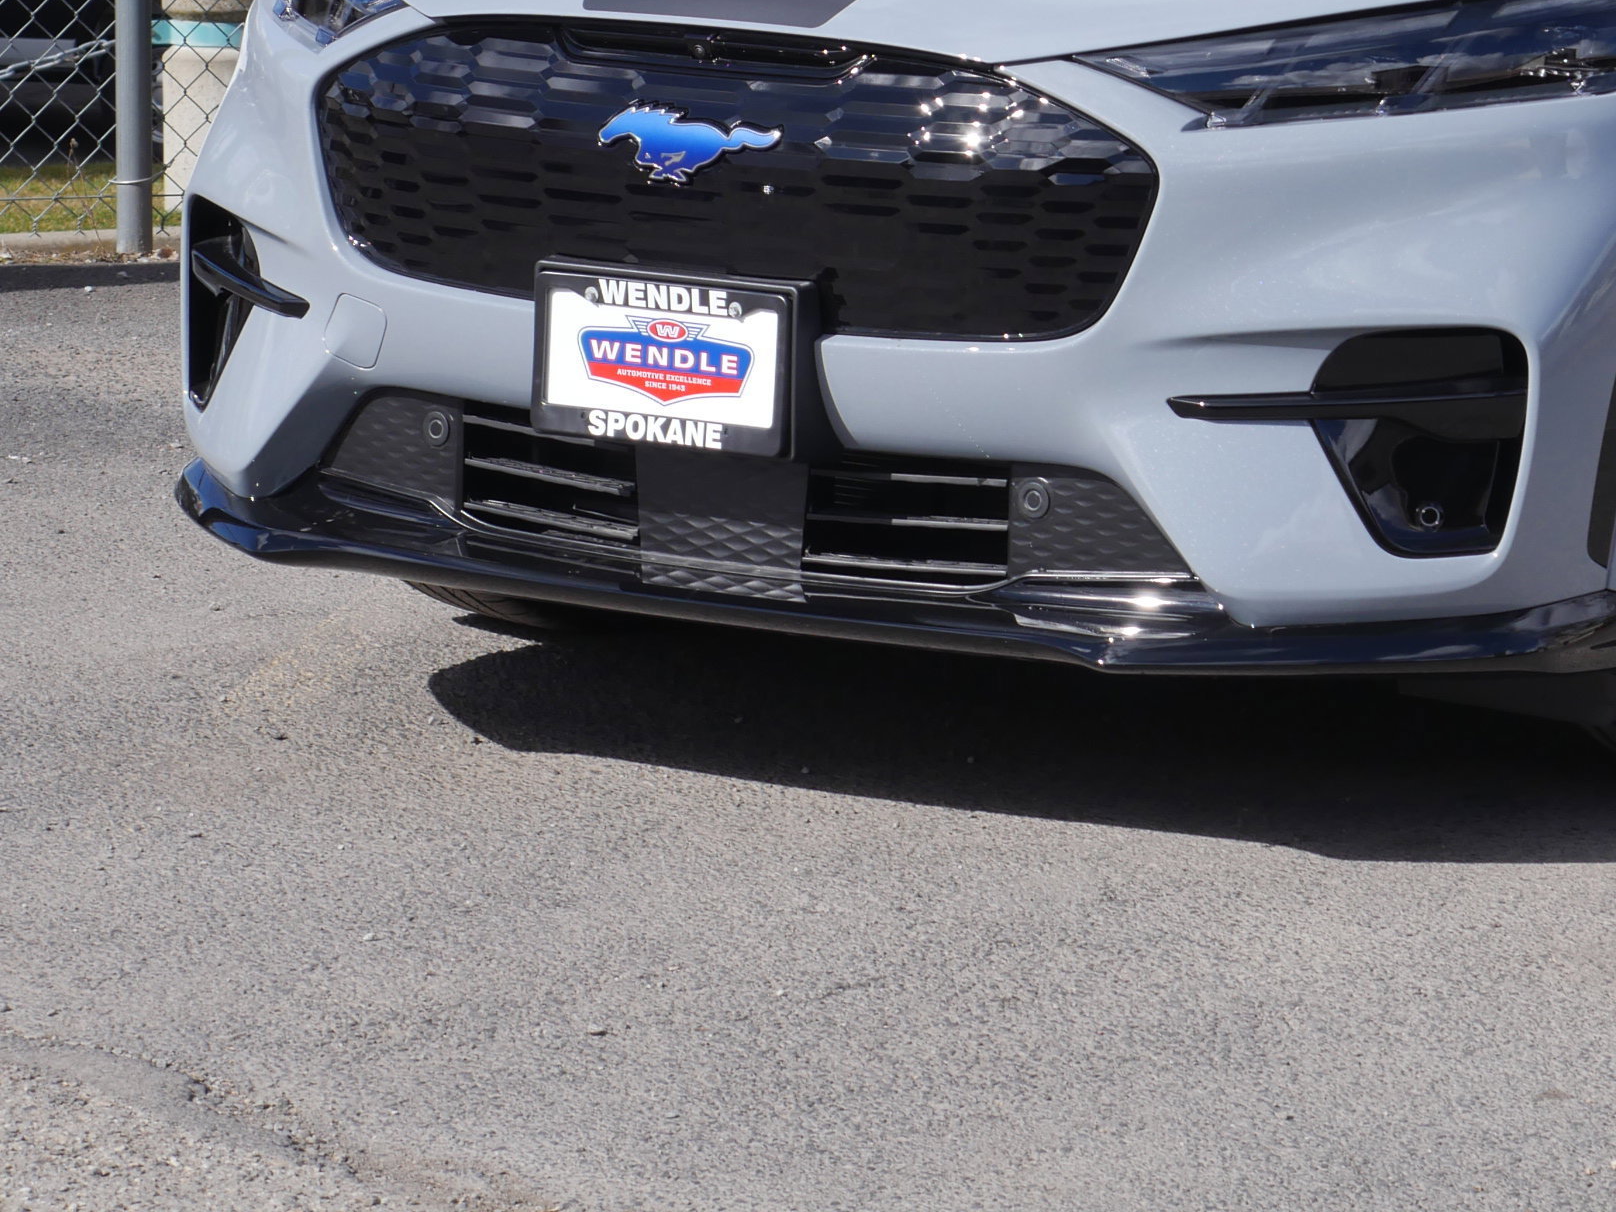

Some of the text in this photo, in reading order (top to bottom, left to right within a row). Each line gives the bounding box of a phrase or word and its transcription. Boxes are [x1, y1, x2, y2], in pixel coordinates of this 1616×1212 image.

[598, 278, 728, 316] WENDLE
[589, 339, 738, 375] WENDLE
[617, 368, 712, 386] AUTOMOTIVE EXCELLENCE
[644, 380, 686, 392] SINCE 1943
[588, 409, 723, 450] SPOKANE
